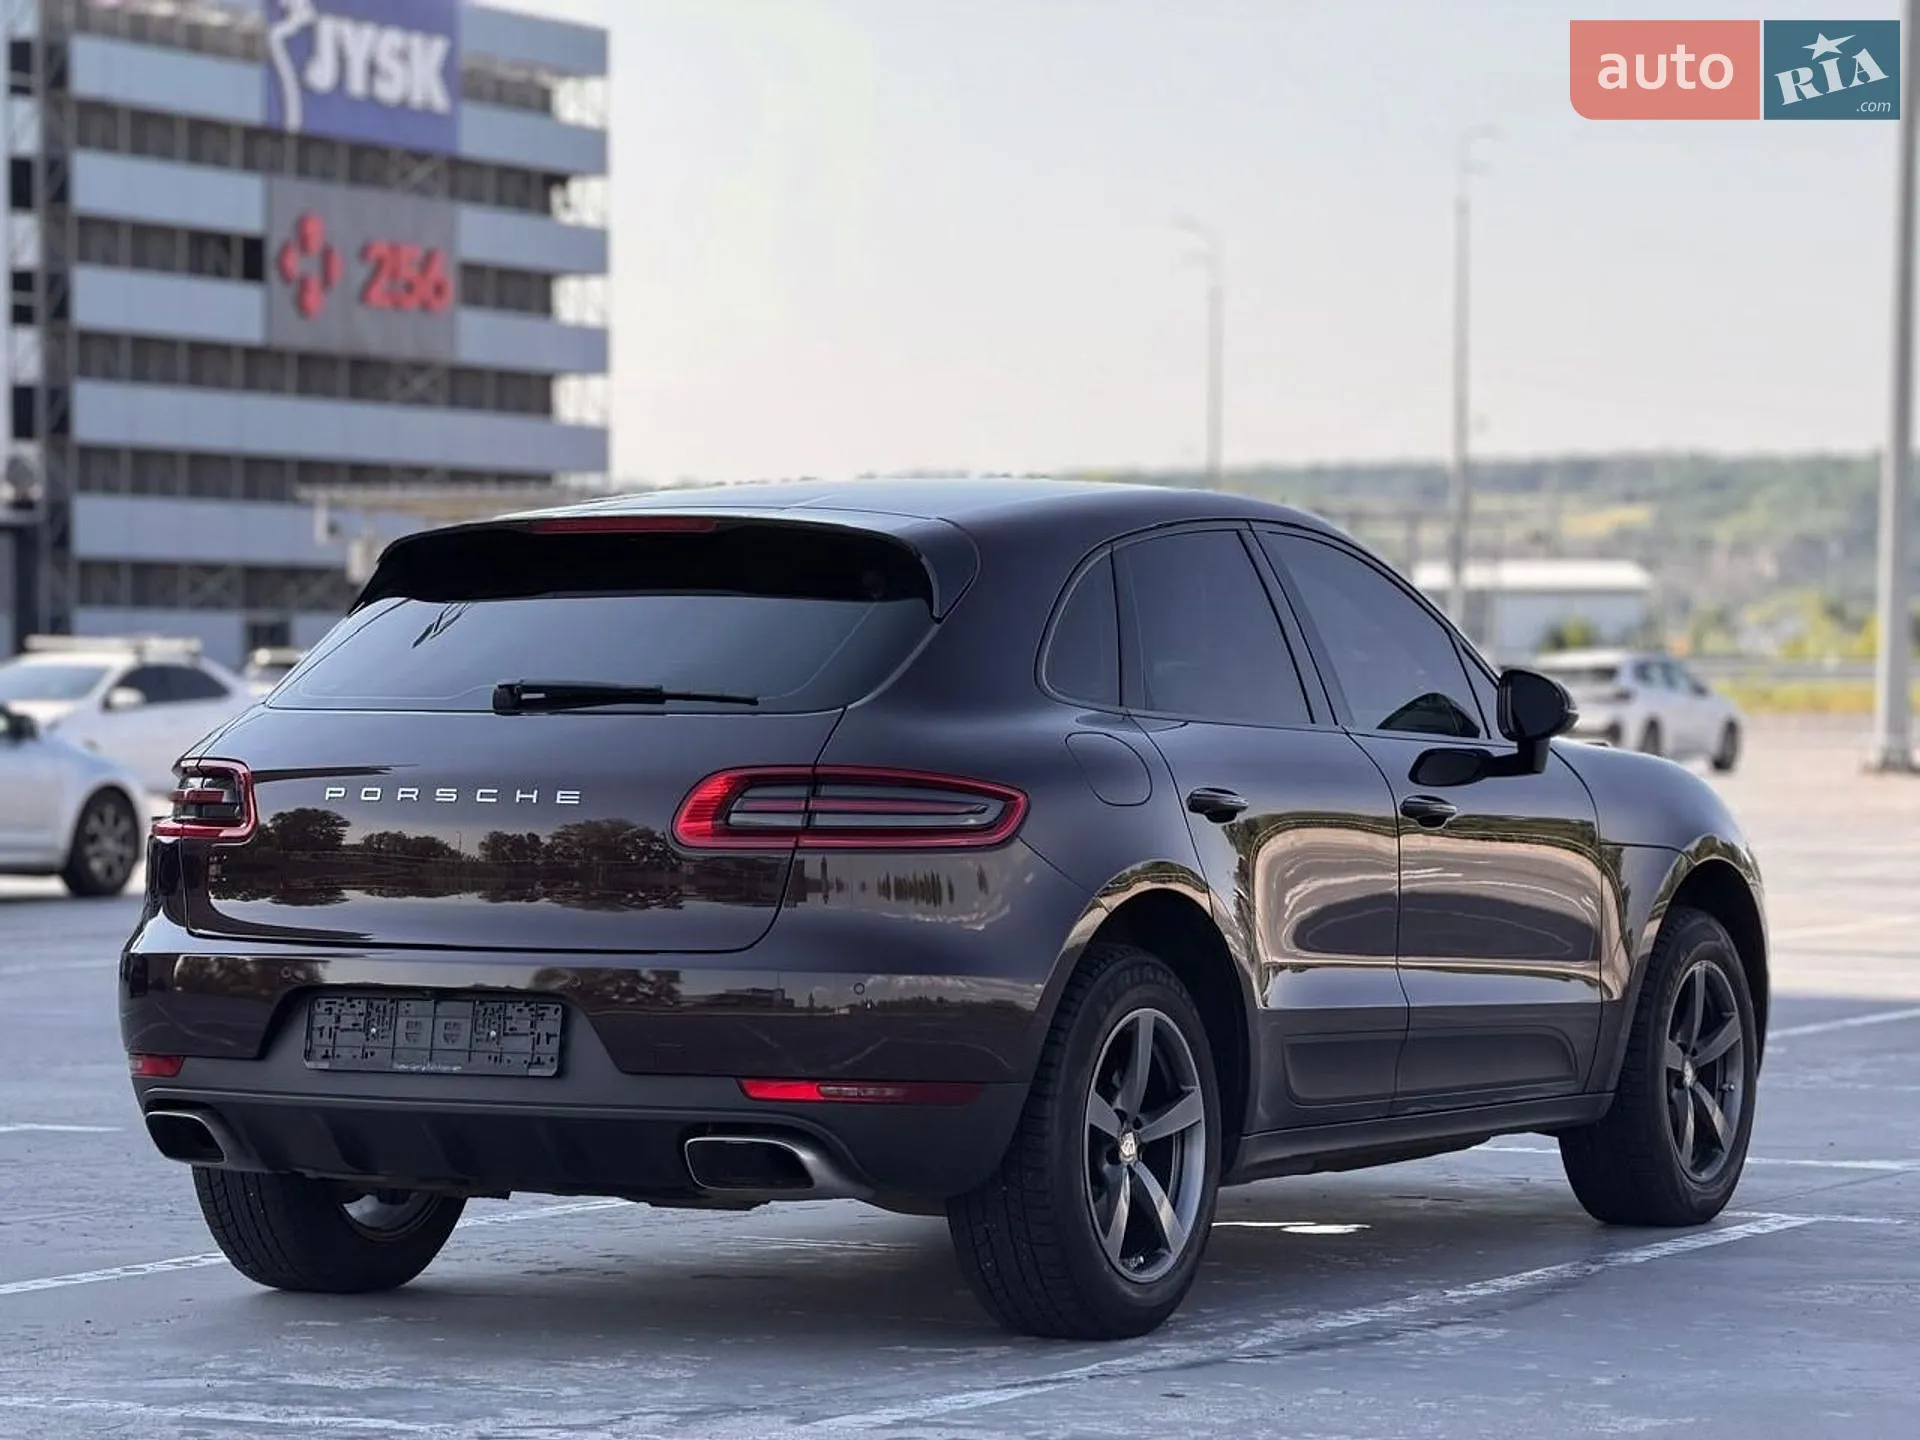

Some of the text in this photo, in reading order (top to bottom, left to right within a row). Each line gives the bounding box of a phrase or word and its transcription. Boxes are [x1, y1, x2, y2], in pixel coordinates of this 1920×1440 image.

[306, 15, 450, 114] JYSK
[361, 239, 454, 313] 256
[325, 787, 580, 804] PORSCHE
